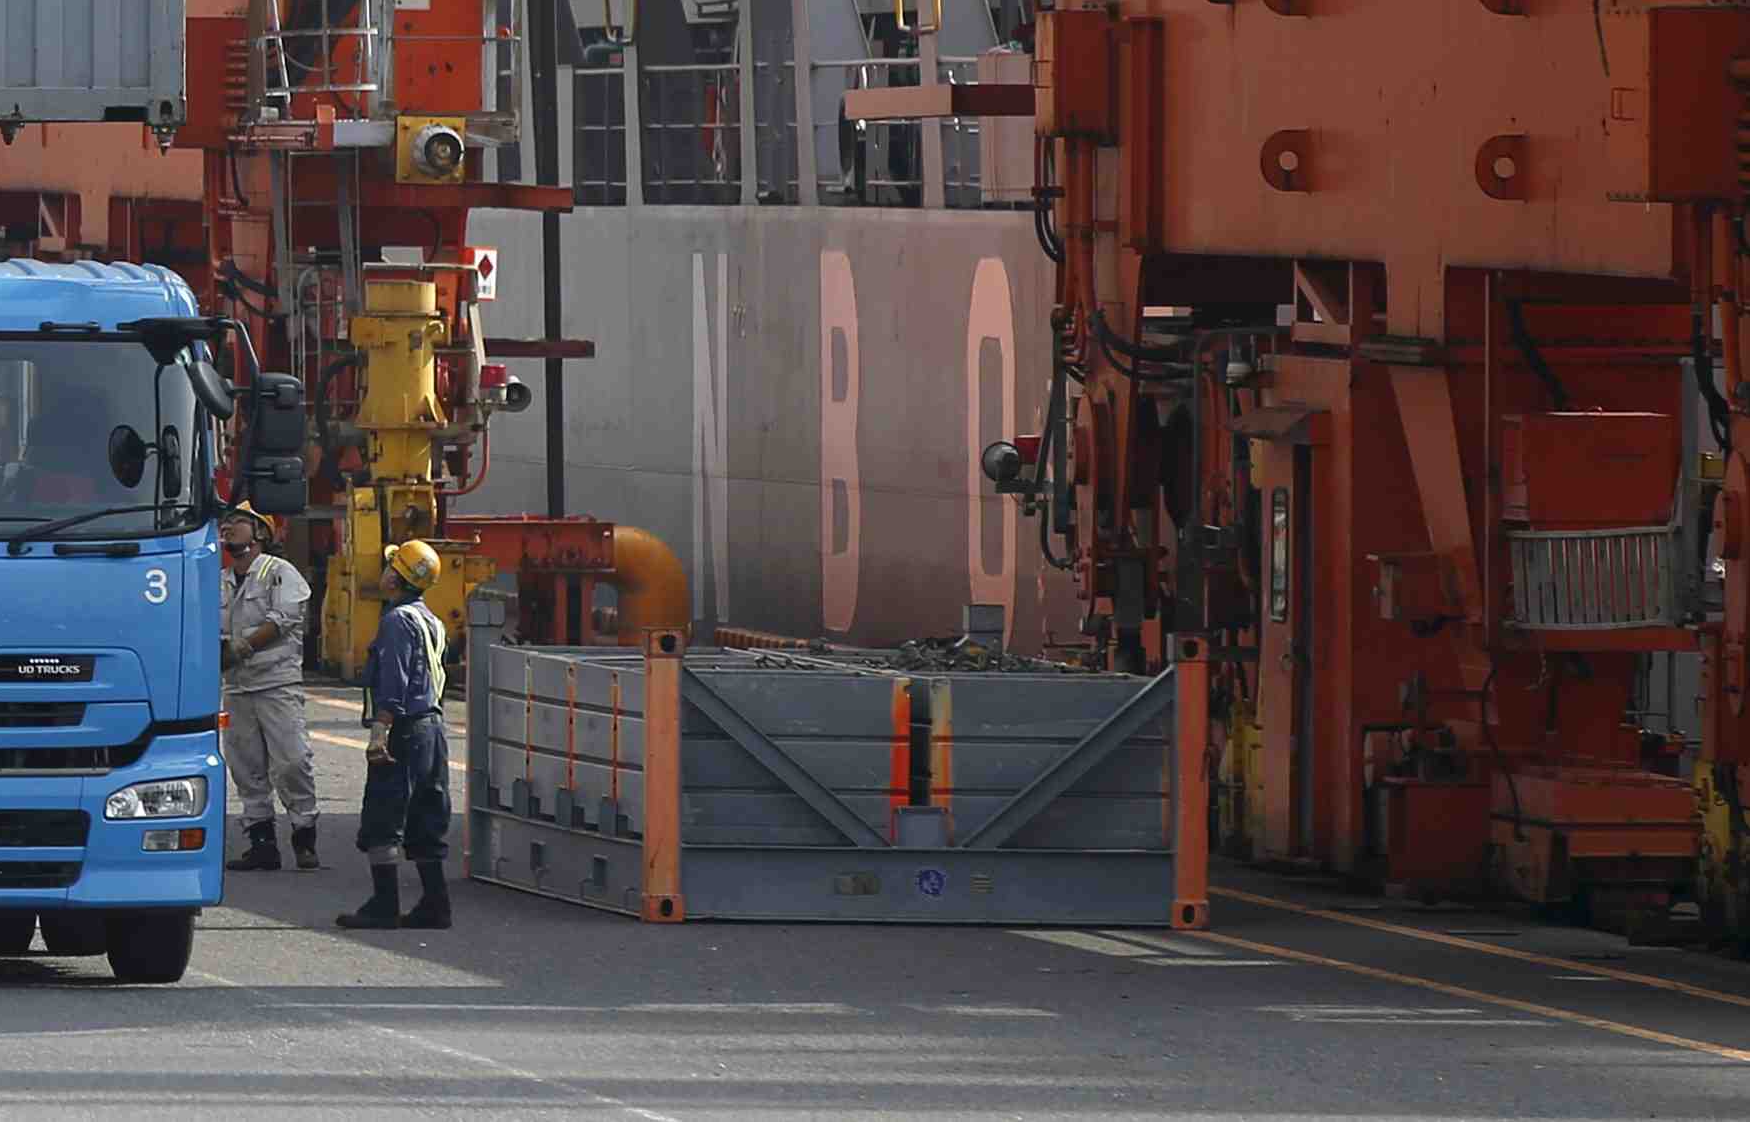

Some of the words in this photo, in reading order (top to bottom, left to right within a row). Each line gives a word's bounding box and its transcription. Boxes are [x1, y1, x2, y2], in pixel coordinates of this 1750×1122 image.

[144, 568, 168, 604] 3
[18, 665, 35, 675] UD
[36, 665, 81, 675] TRUCKS
